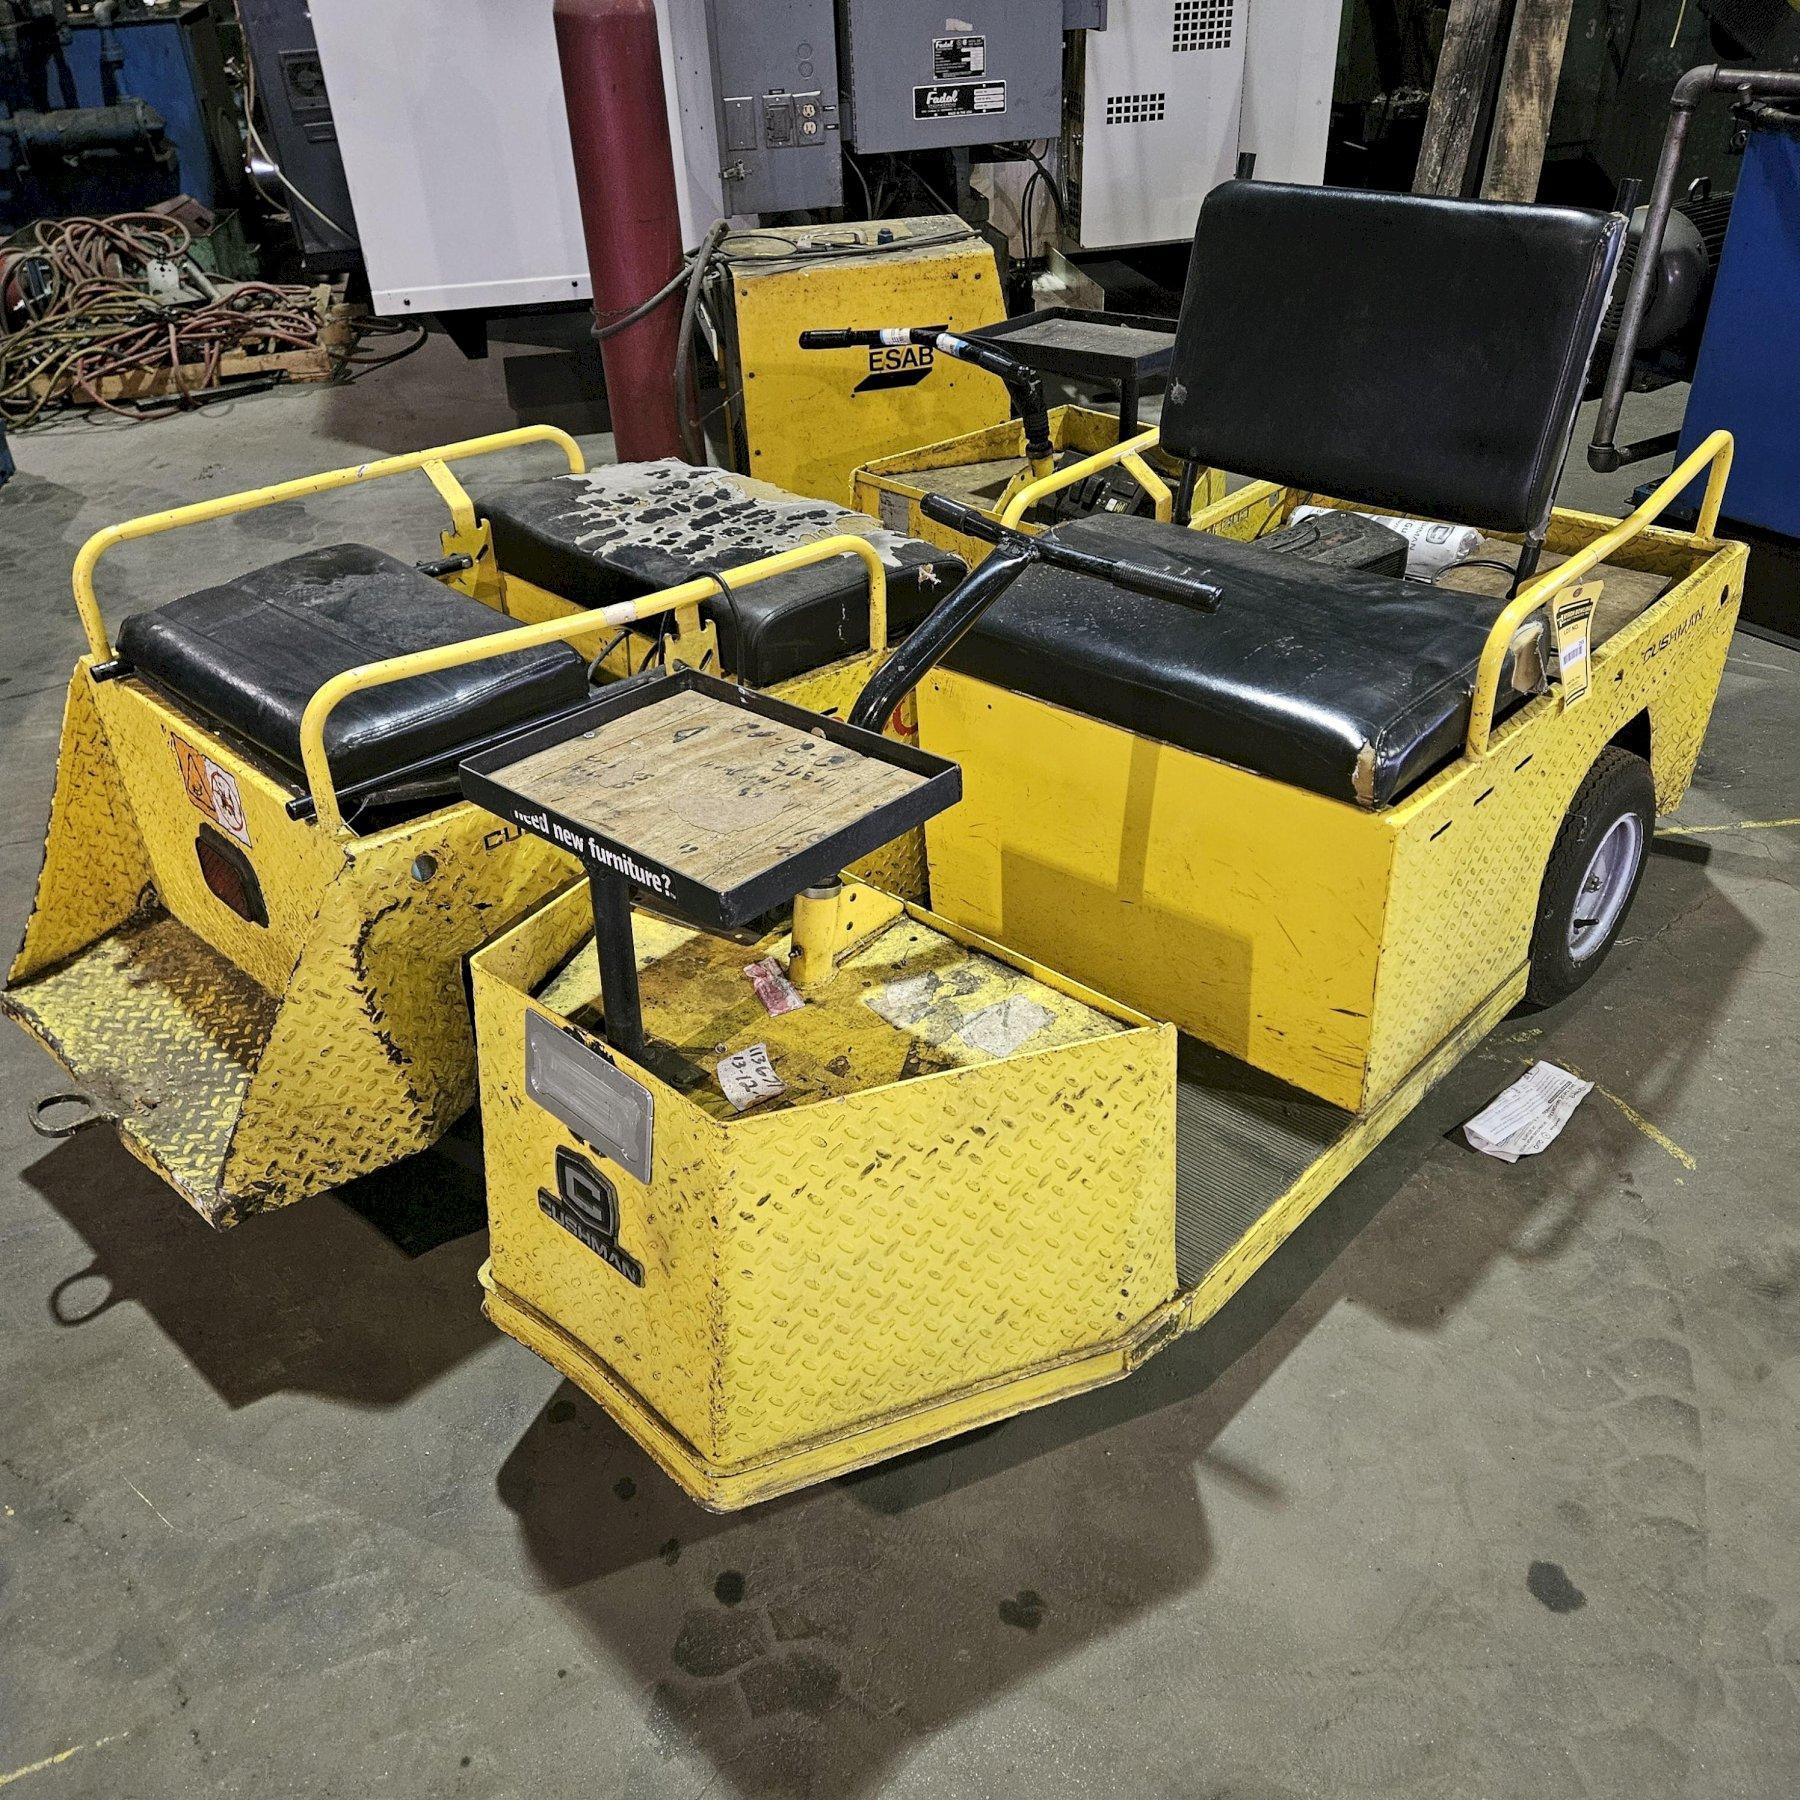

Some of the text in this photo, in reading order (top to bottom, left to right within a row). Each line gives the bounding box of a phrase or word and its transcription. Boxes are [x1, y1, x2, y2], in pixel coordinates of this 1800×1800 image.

[935, 40, 954, 49] Fadal
[926, 89, 958, 105] Fadal
[869, 346, 934, 371] ESAB
[553, 822, 584, 853] new
[588, 837, 671, 896] furniture?
[539, 1196, 638, 1285] CUSHMAN
